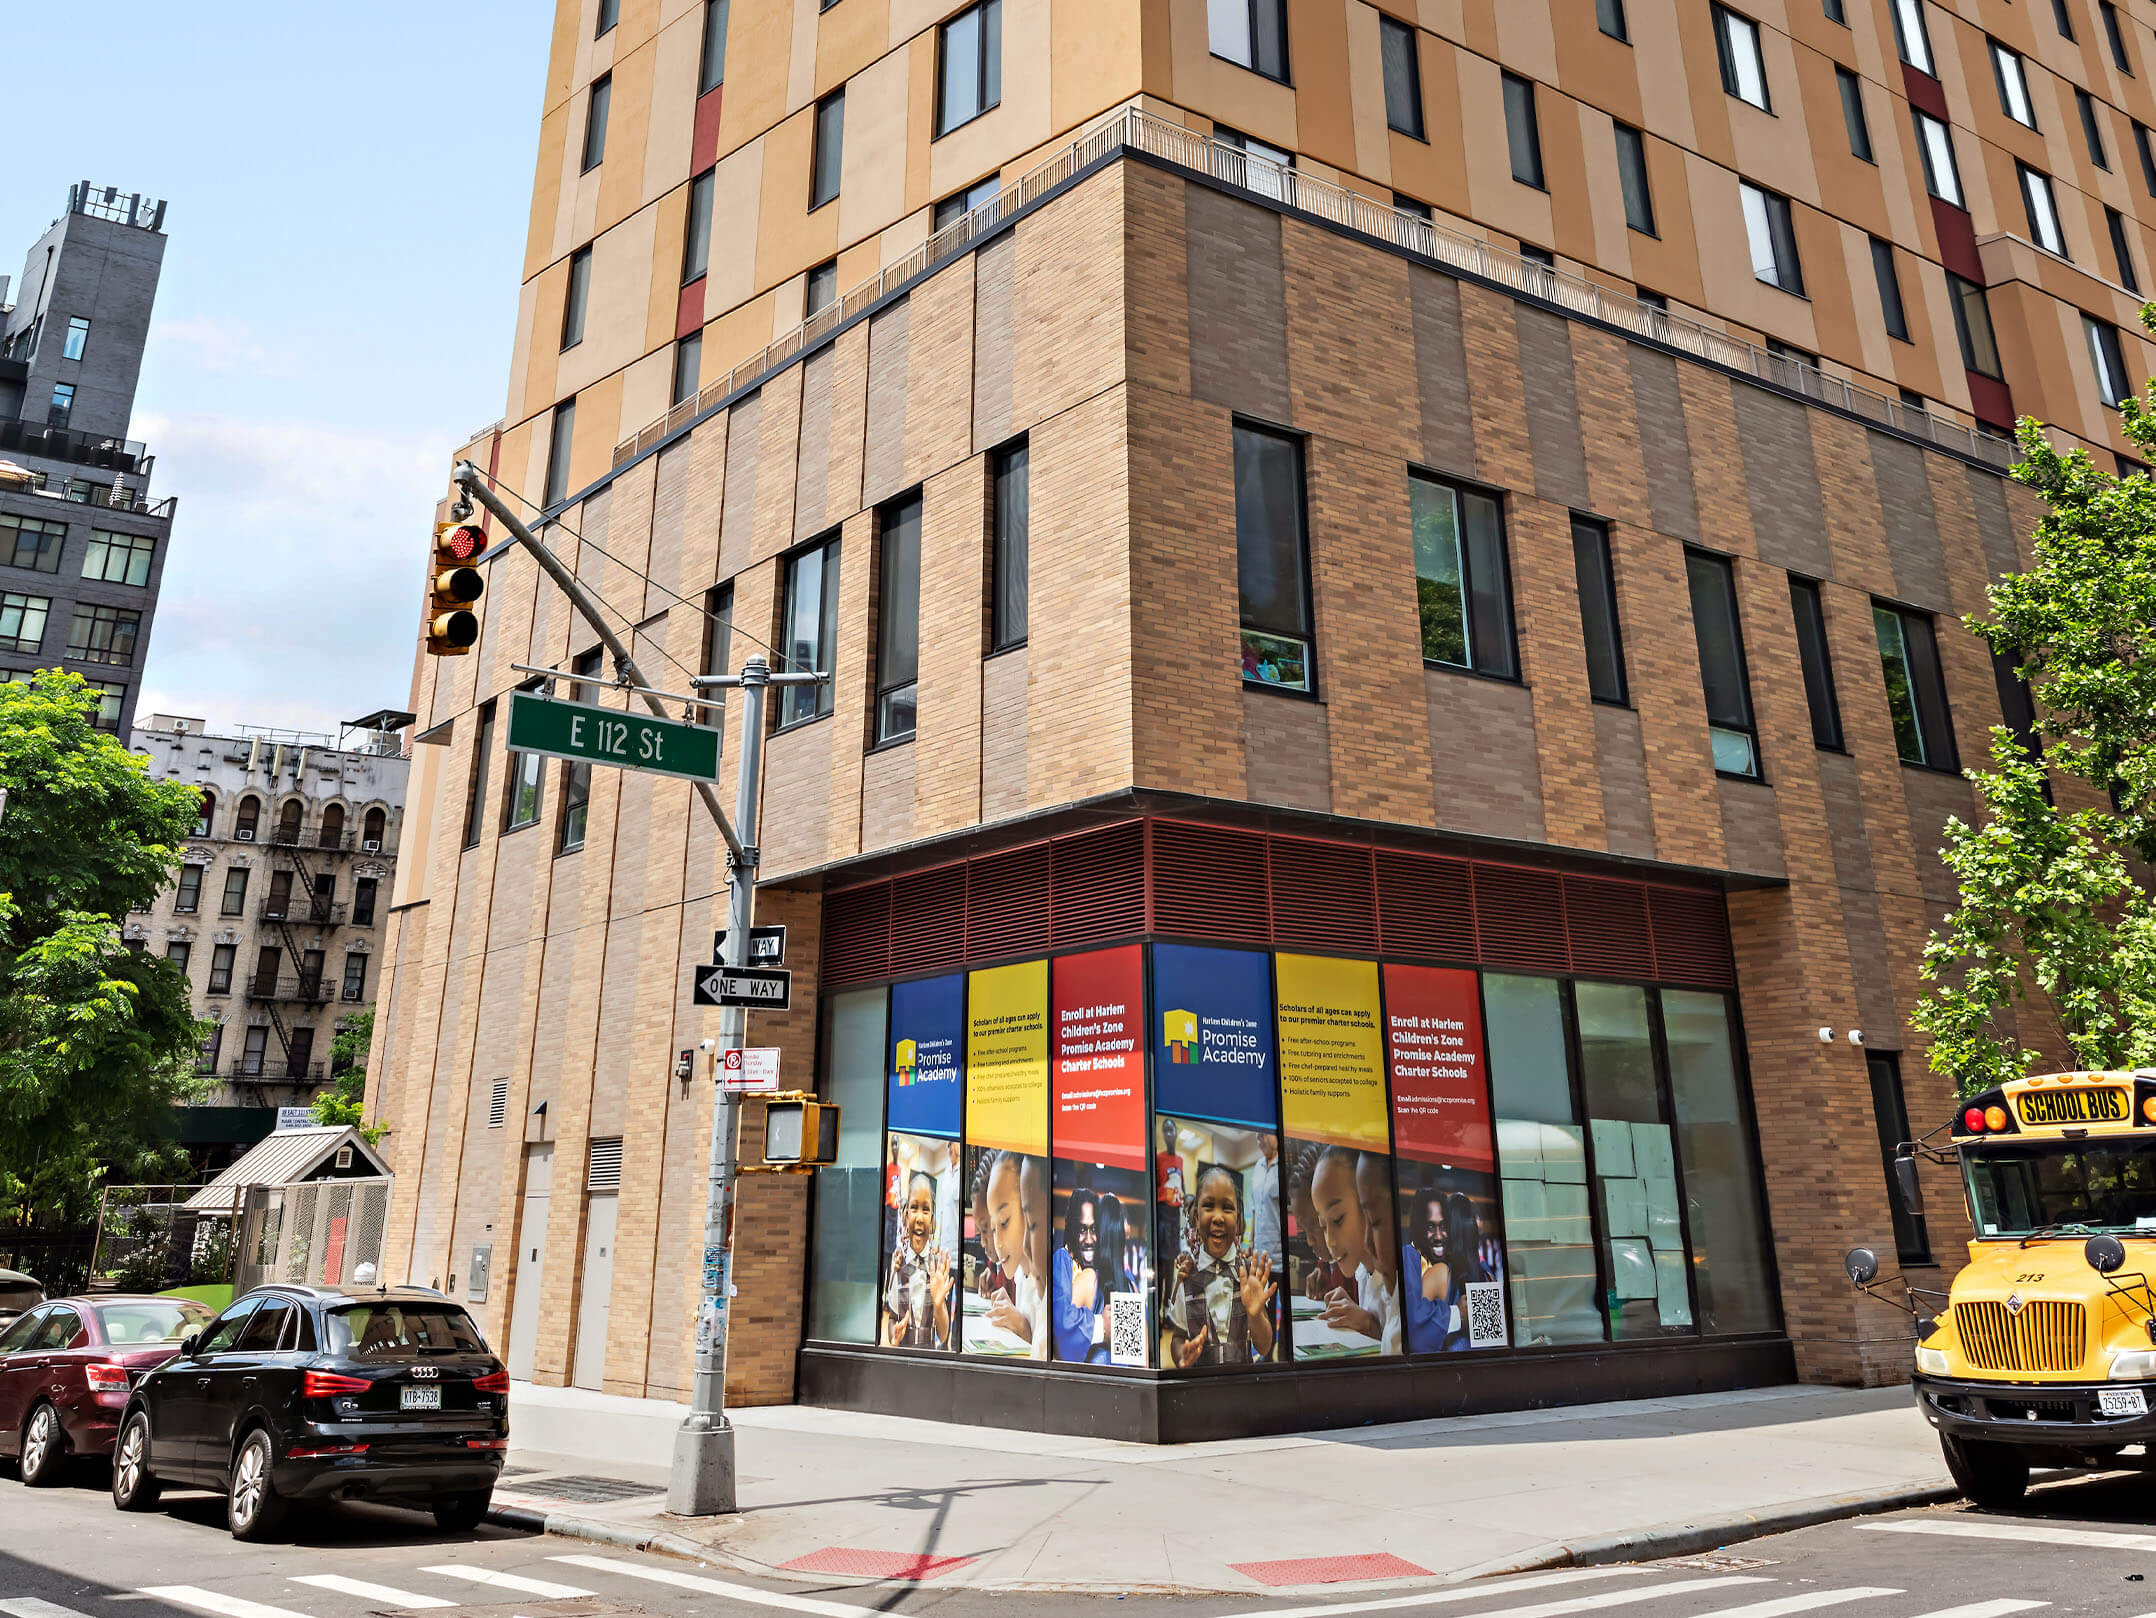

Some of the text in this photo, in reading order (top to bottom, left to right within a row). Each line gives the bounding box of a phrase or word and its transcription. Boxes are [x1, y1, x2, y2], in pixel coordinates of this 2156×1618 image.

[570, 715, 664, 760] E 112 St
[752, 939, 774, 955] WAY
[710, 978, 778, 997] ONE WAY
[1027, 1012, 1040, 1020] apply
[1061, 1004, 1125, 1022] Enroll at Harlem
[1280, 1004, 1306, 1012] Scholars
[1316, 1006, 1324, 1014] all
[1325, 1008, 1340, 1016] ages
[1354, 1010, 1370, 1018] apply
[1280, 1014, 1288, 1022] to
[1300, 1016, 1326, 1025] premier
[1327, 1018, 1350, 1026] charter
[1390, 1016, 1464, 1030] Enroll at Harlem
[1061, 1022, 1124, 1038] Children's Zone
[1202, 1029, 1256, 1048] Promise
[1392, 1032, 1464, 1046] Children's Zone
[1061, 1038, 1134, 1056] Promise Academy
[918, 1050, 952, 1066] Promise
[1061, 1054, 1125, 1072] Charter Schools
[1202, 1046, 1266, 1069] Academy
[1394, 1048, 1476, 1064] Promise Academy
[916, 1065, 958, 1083] Academy
[1394, 1064, 1468, 1078] Charter Schools
[2024, 1089, 2121, 1122] SCHOOL BUS
[2016, 1273, 2045, 1282] 213
